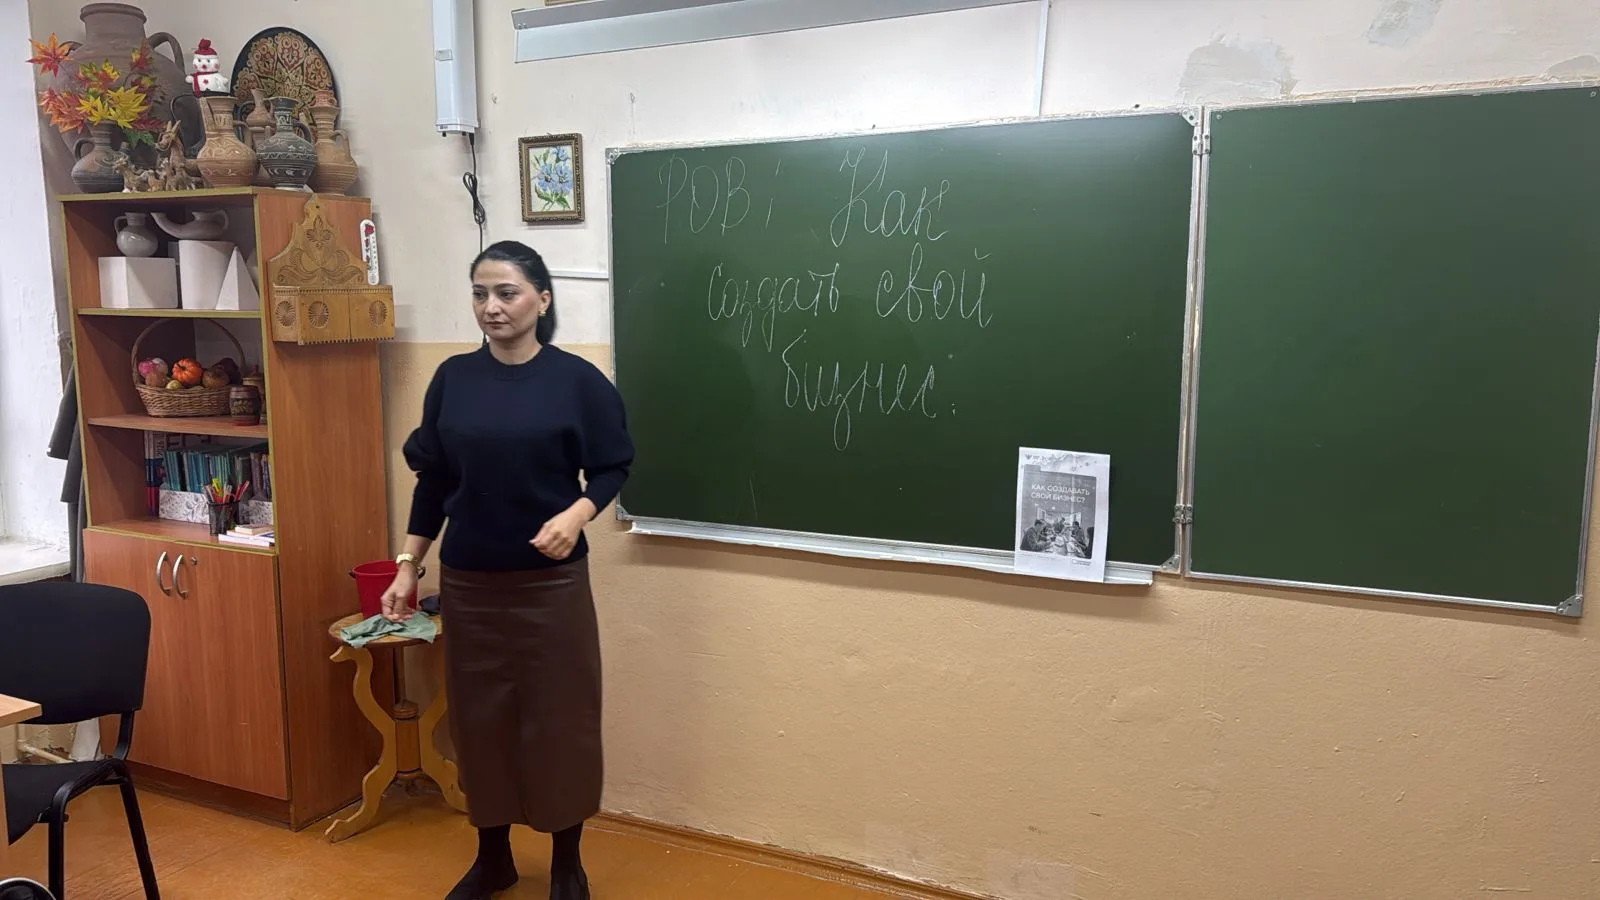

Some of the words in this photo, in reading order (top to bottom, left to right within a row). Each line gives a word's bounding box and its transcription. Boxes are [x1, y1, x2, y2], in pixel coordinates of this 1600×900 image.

[830, 146, 950, 248] Как
[876, 242, 993, 328] свой
[1031, 484, 1046, 492] КАК
[1047, 485, 1090, 496] СОЗДАВАТЬ
[1053, 493, 1086, 503] БИЗНЕС?
